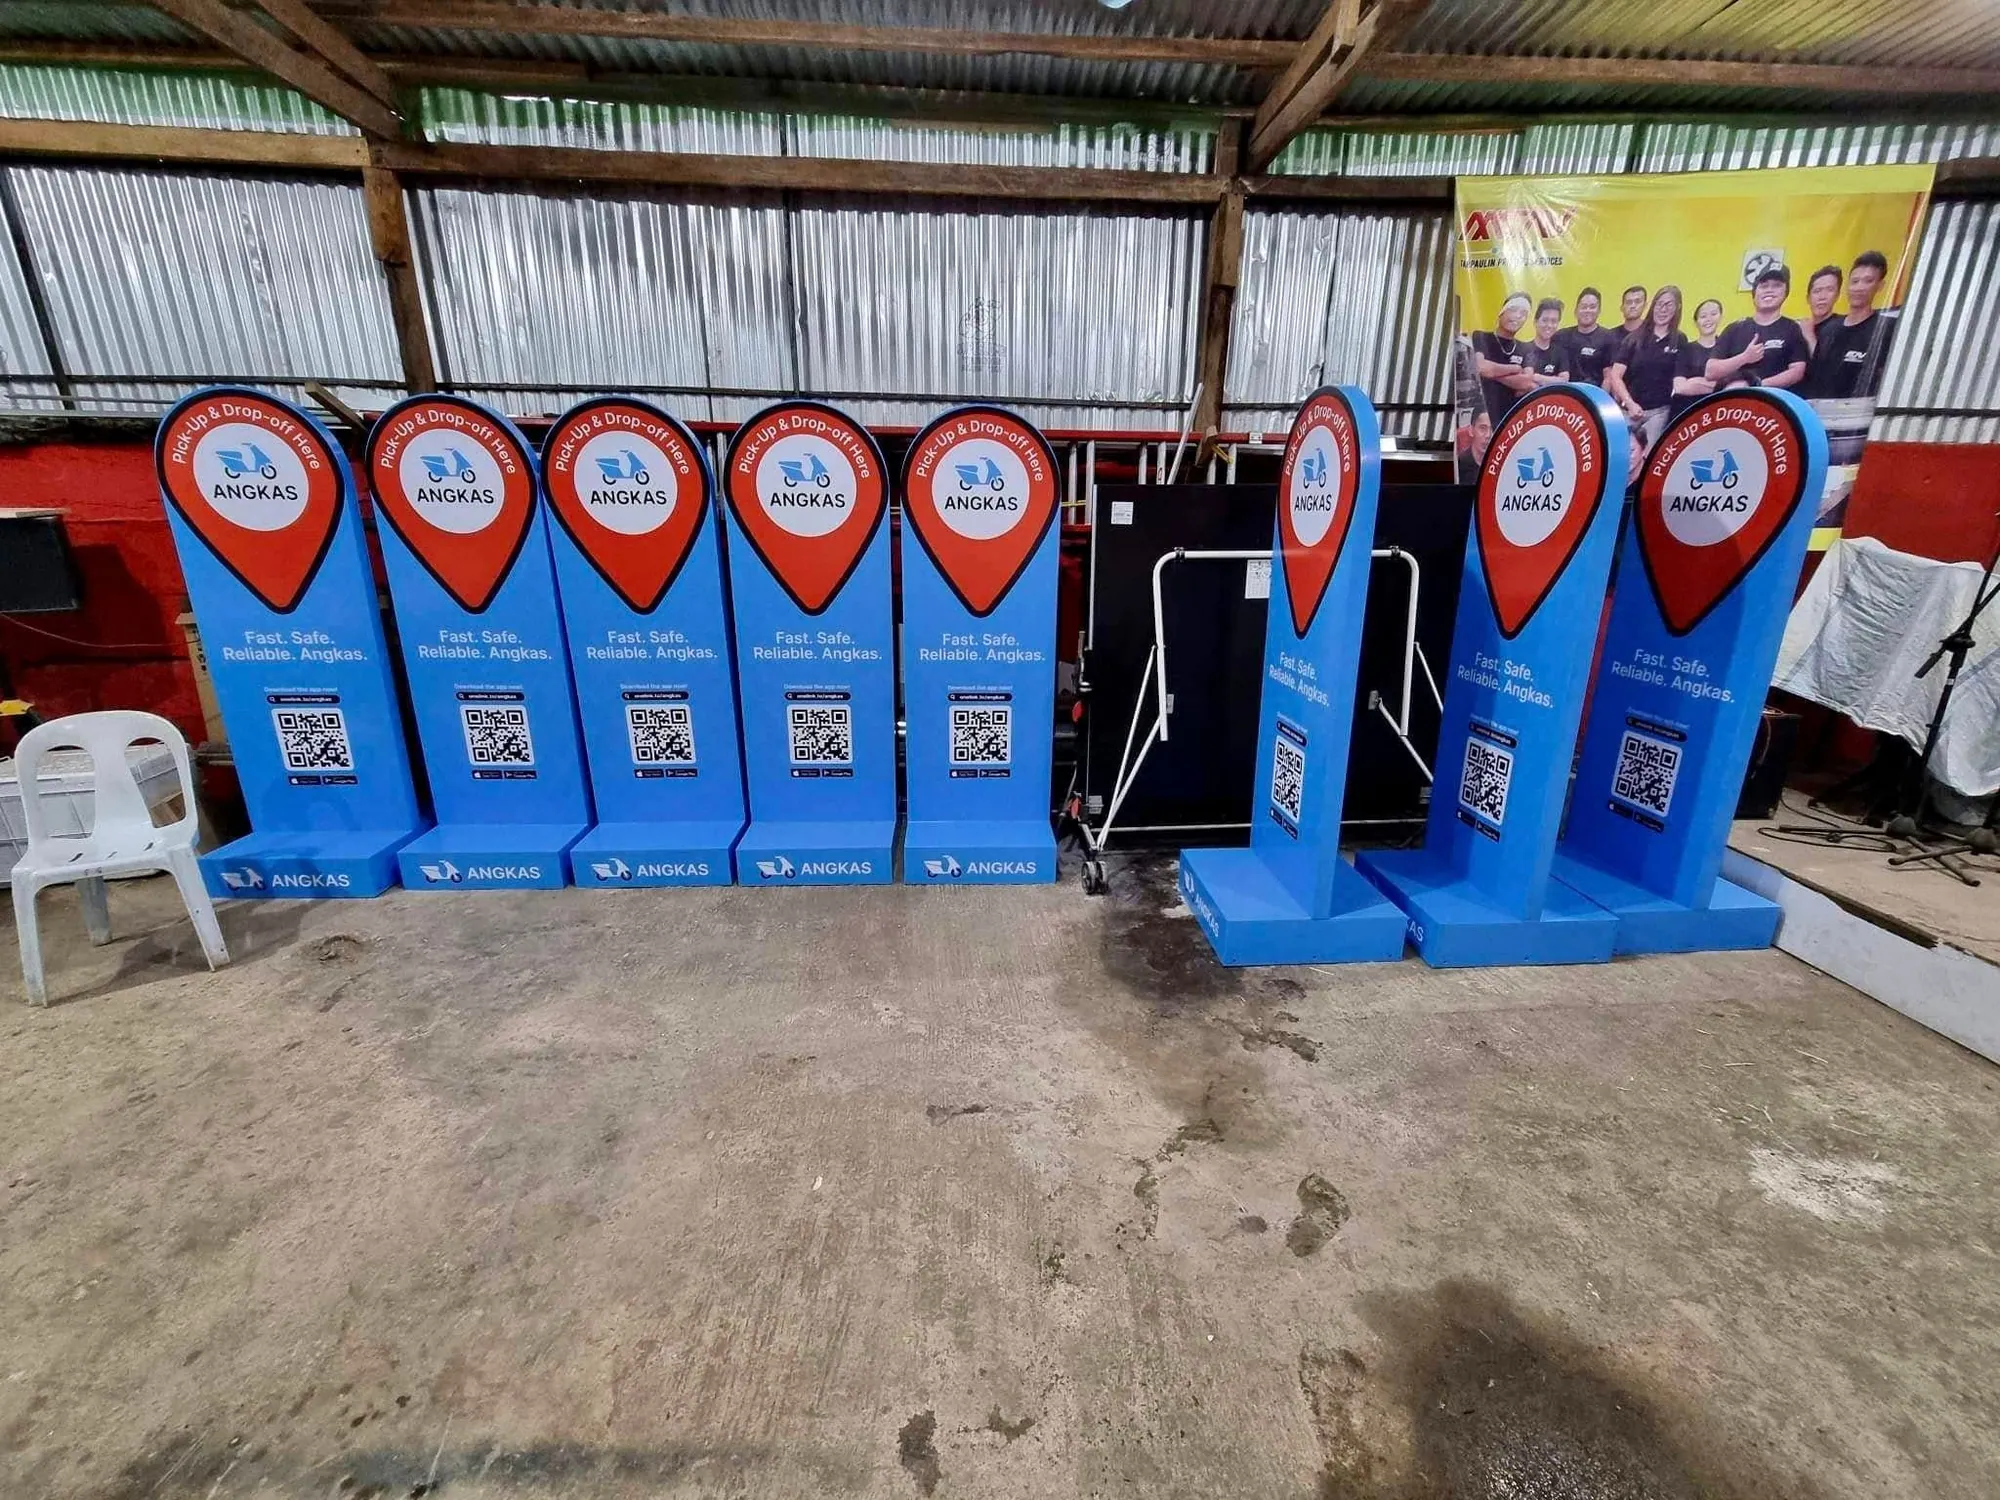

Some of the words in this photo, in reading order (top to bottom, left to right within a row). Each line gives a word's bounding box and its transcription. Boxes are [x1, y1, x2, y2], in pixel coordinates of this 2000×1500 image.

[173, 414, 208, 464] Pick-Up
[207, 406, 220, 420] &
[221, 403, 294, 434] Drop-off
[293, 433, 320, 470] Here
[380, 420, 415, 469] Pick-Up
[414, 412, 427, 425] &
[428, 409, 494, 440] Drop-off
[491, 438, 516, 474] Here
[555, 423, 591, 472] Pick-Up
[591, 415, 603, 428] &
[604, 412, 670, 441] Drop-off
[666, 440, 690, 475] Here
[1488, 420, 1524, 476] Pick-Up
[1526, 410, 1534, 424] &
[1536, 403, 1586, 432] Drop-off
[1578, 428, 1592, 473] Here
[1653, 423, 1699, 477] Pick-Up
[1701, 412, 1712, 426] &
[1716, 407, 1779, 436] Drop-off
[1769, 432, 1787, 476] Here
[739, 425, 777, 474] Pick-Up
[778, 418, 789, 430] &
[791, 415, 853, 445] Drop-off
[849, 443, 870, 479] Here
[916, 430, 955, 478] Pick-Up
[956, 423, 968, 435] &
[970, 420, 1029, 449] Drop-off
[1025, 447, 1043, 482] Here
[214, 485, 298, 500] ANGKAS
[417, 488, 494, 504] ANGKAS
[590, 490, 667, 505] ANGKAS
[770, 493, 845, 508] ANGKAS
[944, 496, 1018, 511] ANGKAS
[1294, 494, 1332, 512] ANGKAS
[1501, 494, 1563, 512] ANGKAS
[1669, 495, 1748, 512] ANGKAS
[244, 631, 288, 644] Fast.
[292, 631, 335, 644] Safe.
[439, 630, 478, 643] Fast.
[482, 630, 522, 644] Safe.
[607, 630, 645, 643] Fast.
[650, 630, 688, 643] Safe.
[776, 631, 813, 644] Fast.
[816, 631, 855, 644] Safe.
[942, 633, 978, 646] Fast.
[982, 633, 1020, 646] Safe.
[223, 647, 296, 661] Reliable.
[300, 647, 368, 663] Angkas.
[419, 645, 485, 659] Reliable.
[489, 646, 552, 662] Angkas.
[587, 646, 652, 659] Reliable.
[656, 647, 718, 661] Angkas.
[753, 647, 817, 659] Reliable.
[822, 647, 882, 662] Angkas.
[920, 648, 982, 661] Reliable.
[986, 649, 1045, 663] Angkas.
[1279, 652, 1297, 671] Fast.
[1298, 659, 1318, 681] Safe.
[1475, 652, 1500, 671] Fast.
[1503, 659, 1534, 682] Safe.
[1634, 648, 1667, 668] Fast.
[1671, 656, 1710, 678] Safe.
[1269, 664, 1297, 690] Reliable.
[1297, 680, 1330, 708] Angkas.
[1457, 664, 1501, 691] Reliable.
[1503, 680, 1554, 708] Angkas.
[1611, 661, 1667, 687] Reliable.
[1671, 675, 1735, 703] Angkas.
[467, 866, 541, 880] ANGKAS
[637, 863, 710, 877] ANGKAS
[801, 862, 872, 875] ANGKAS
[967, 861, 1037, 874] ANGKAS
[272, 874, 350, 887] ANGKAS
